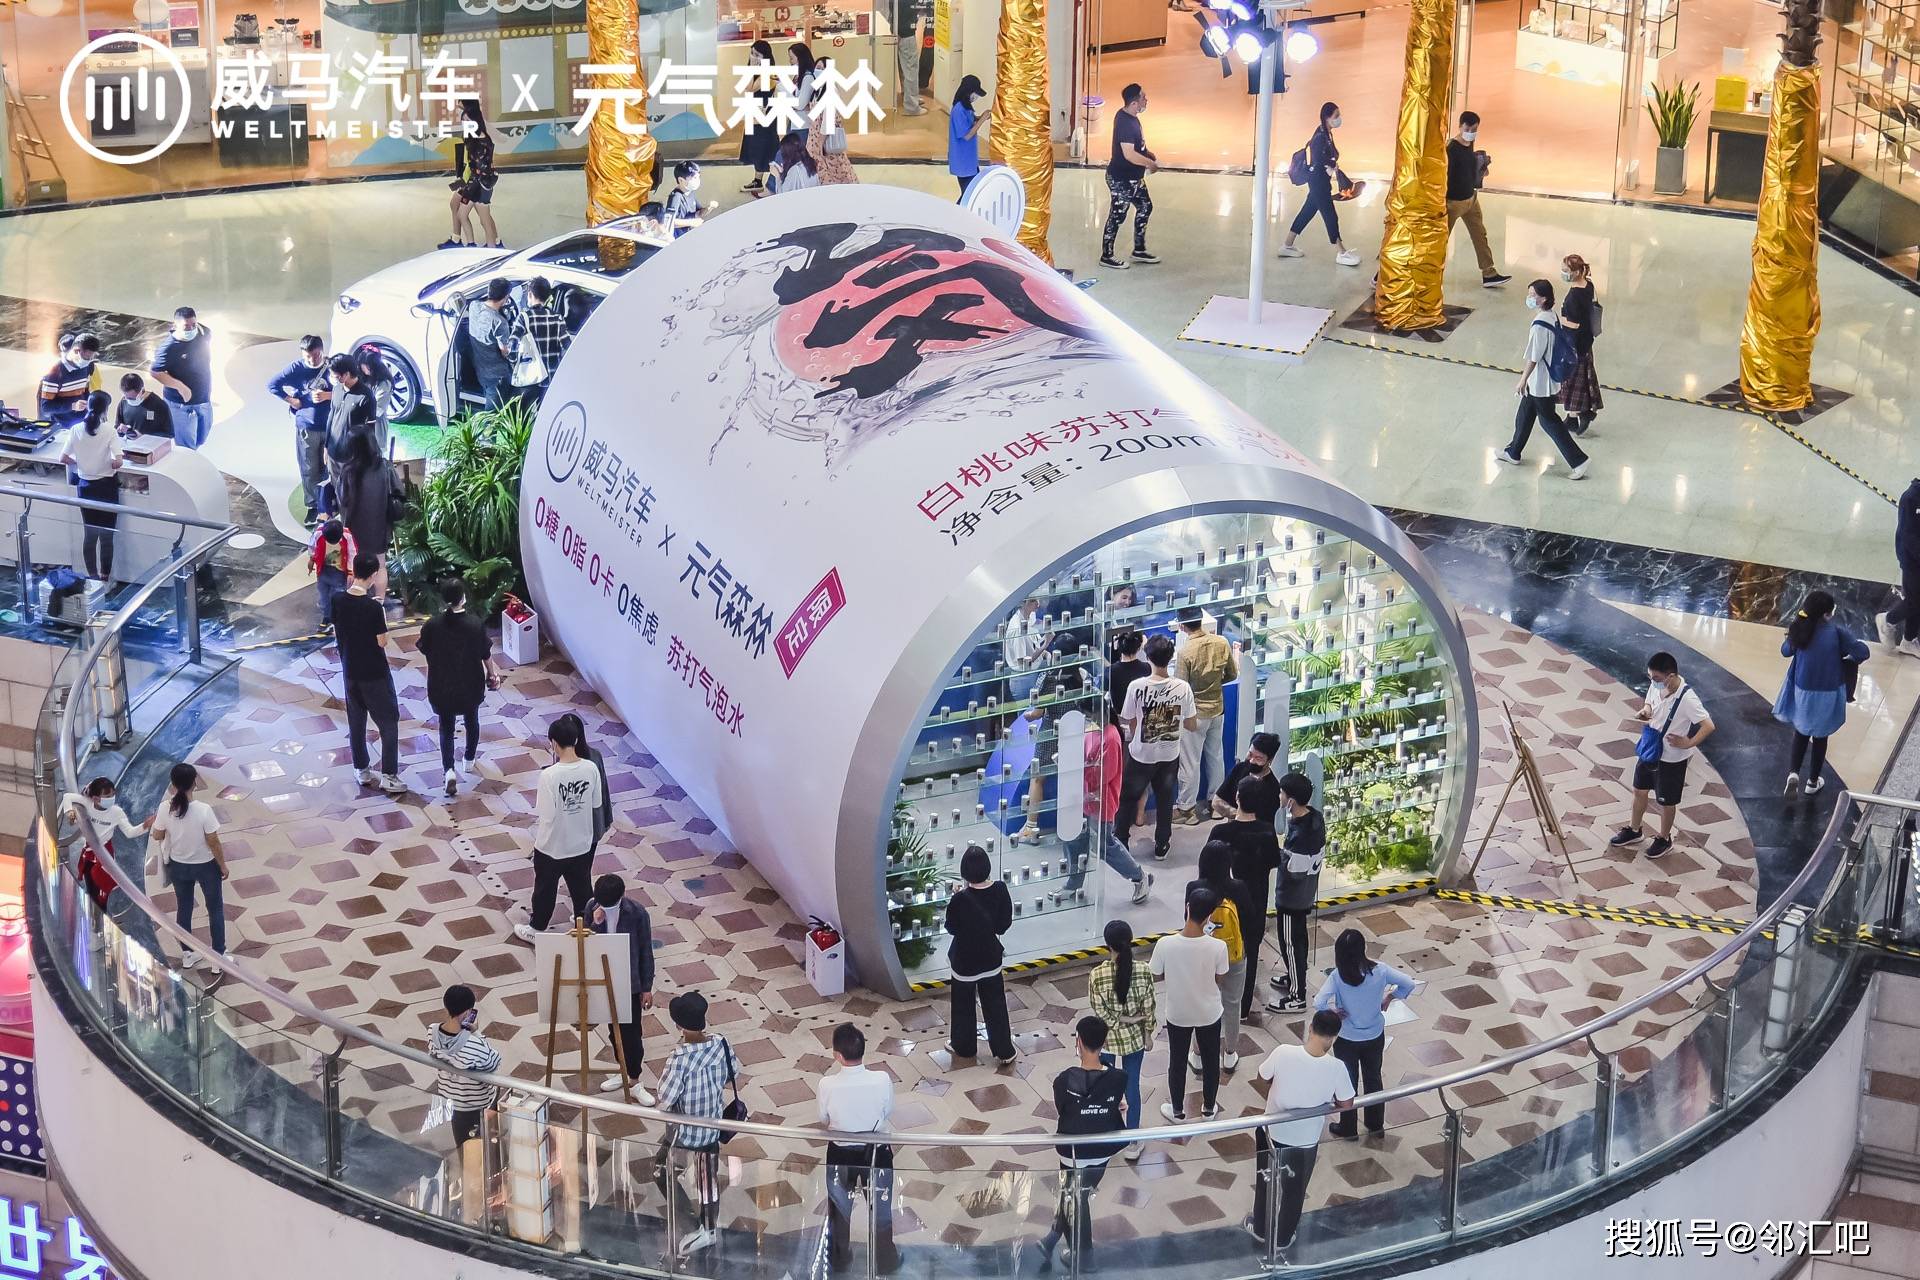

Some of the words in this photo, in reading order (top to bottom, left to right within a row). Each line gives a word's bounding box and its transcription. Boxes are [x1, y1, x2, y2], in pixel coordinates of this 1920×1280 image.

[577, 474, 643, 548] WELTMEISTER
[582, 439, 657, 525] 威马汽车
[680, 540, 774, 660] 元气森林
[589, 553, 615, 597] 0卡
[667, 635, 745, 739] 苏打气泡水
[785, 586, 833, 658] 限定
